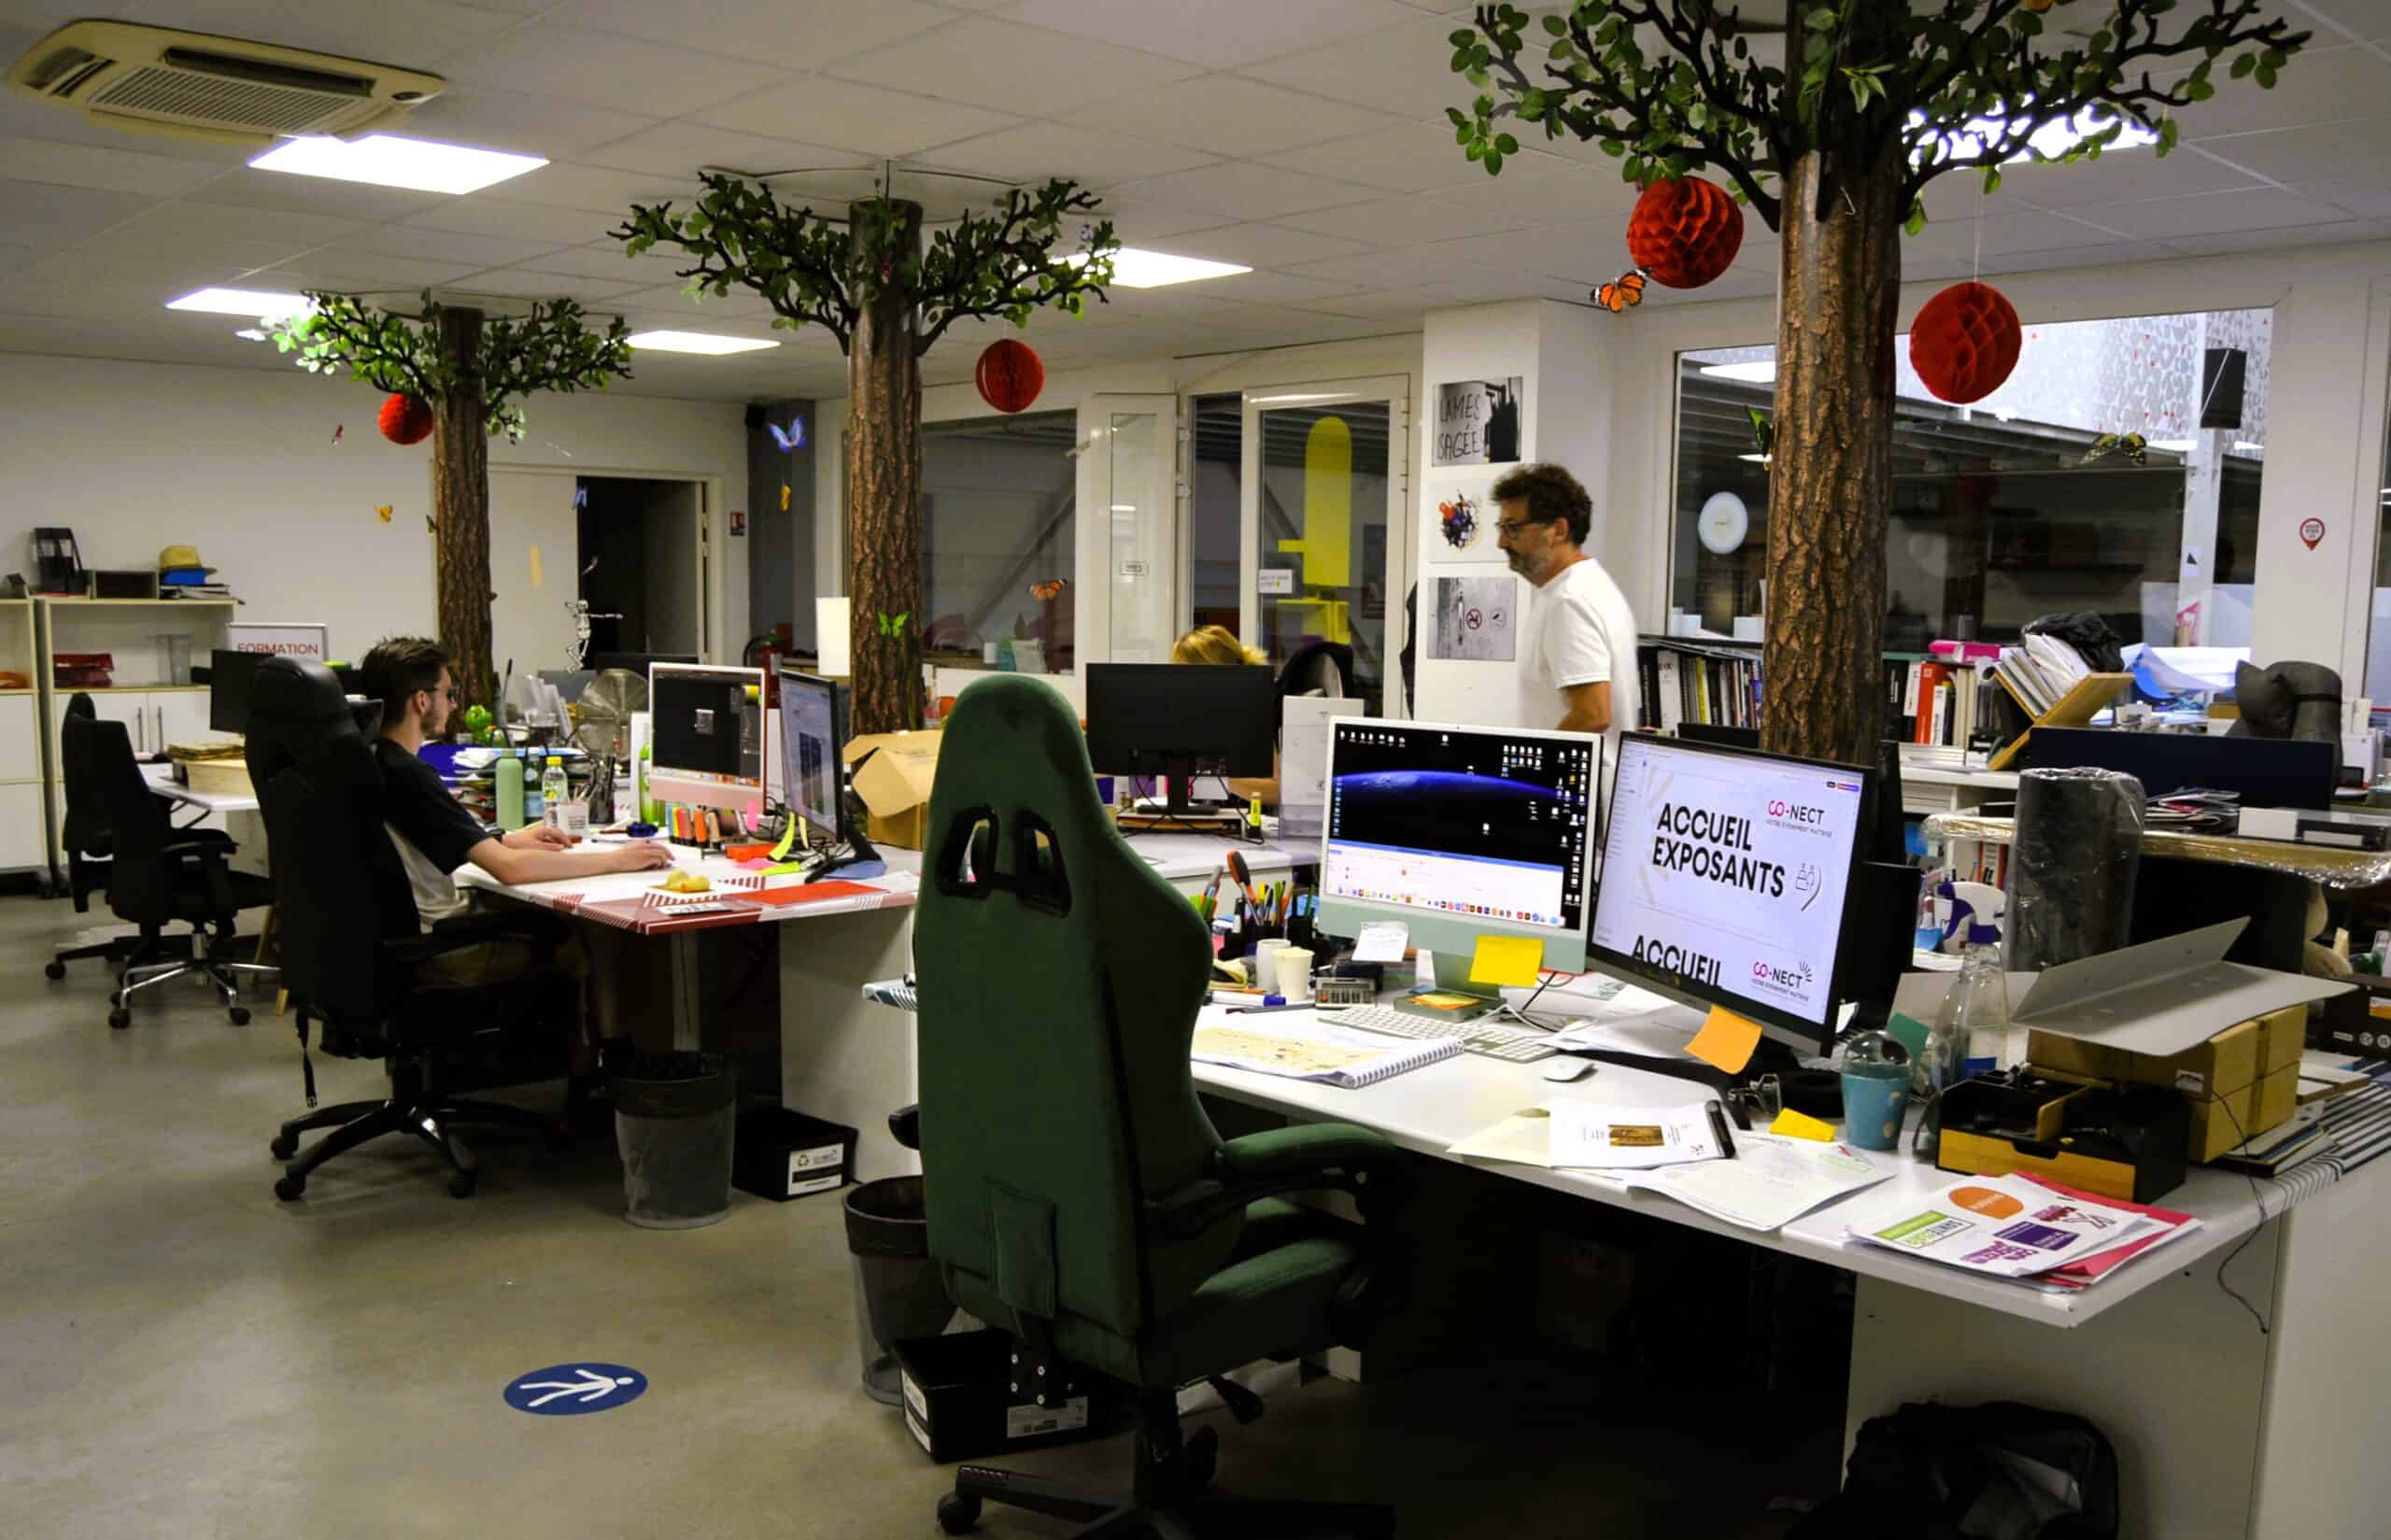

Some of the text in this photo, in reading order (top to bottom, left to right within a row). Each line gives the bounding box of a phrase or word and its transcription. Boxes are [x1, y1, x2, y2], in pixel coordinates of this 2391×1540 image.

[237, 642, 319, 655] FORMATION
[1656, 802, 1752, 852] ACCUEIL
[1651, 836, 1786, 897] EXPOSANTS
